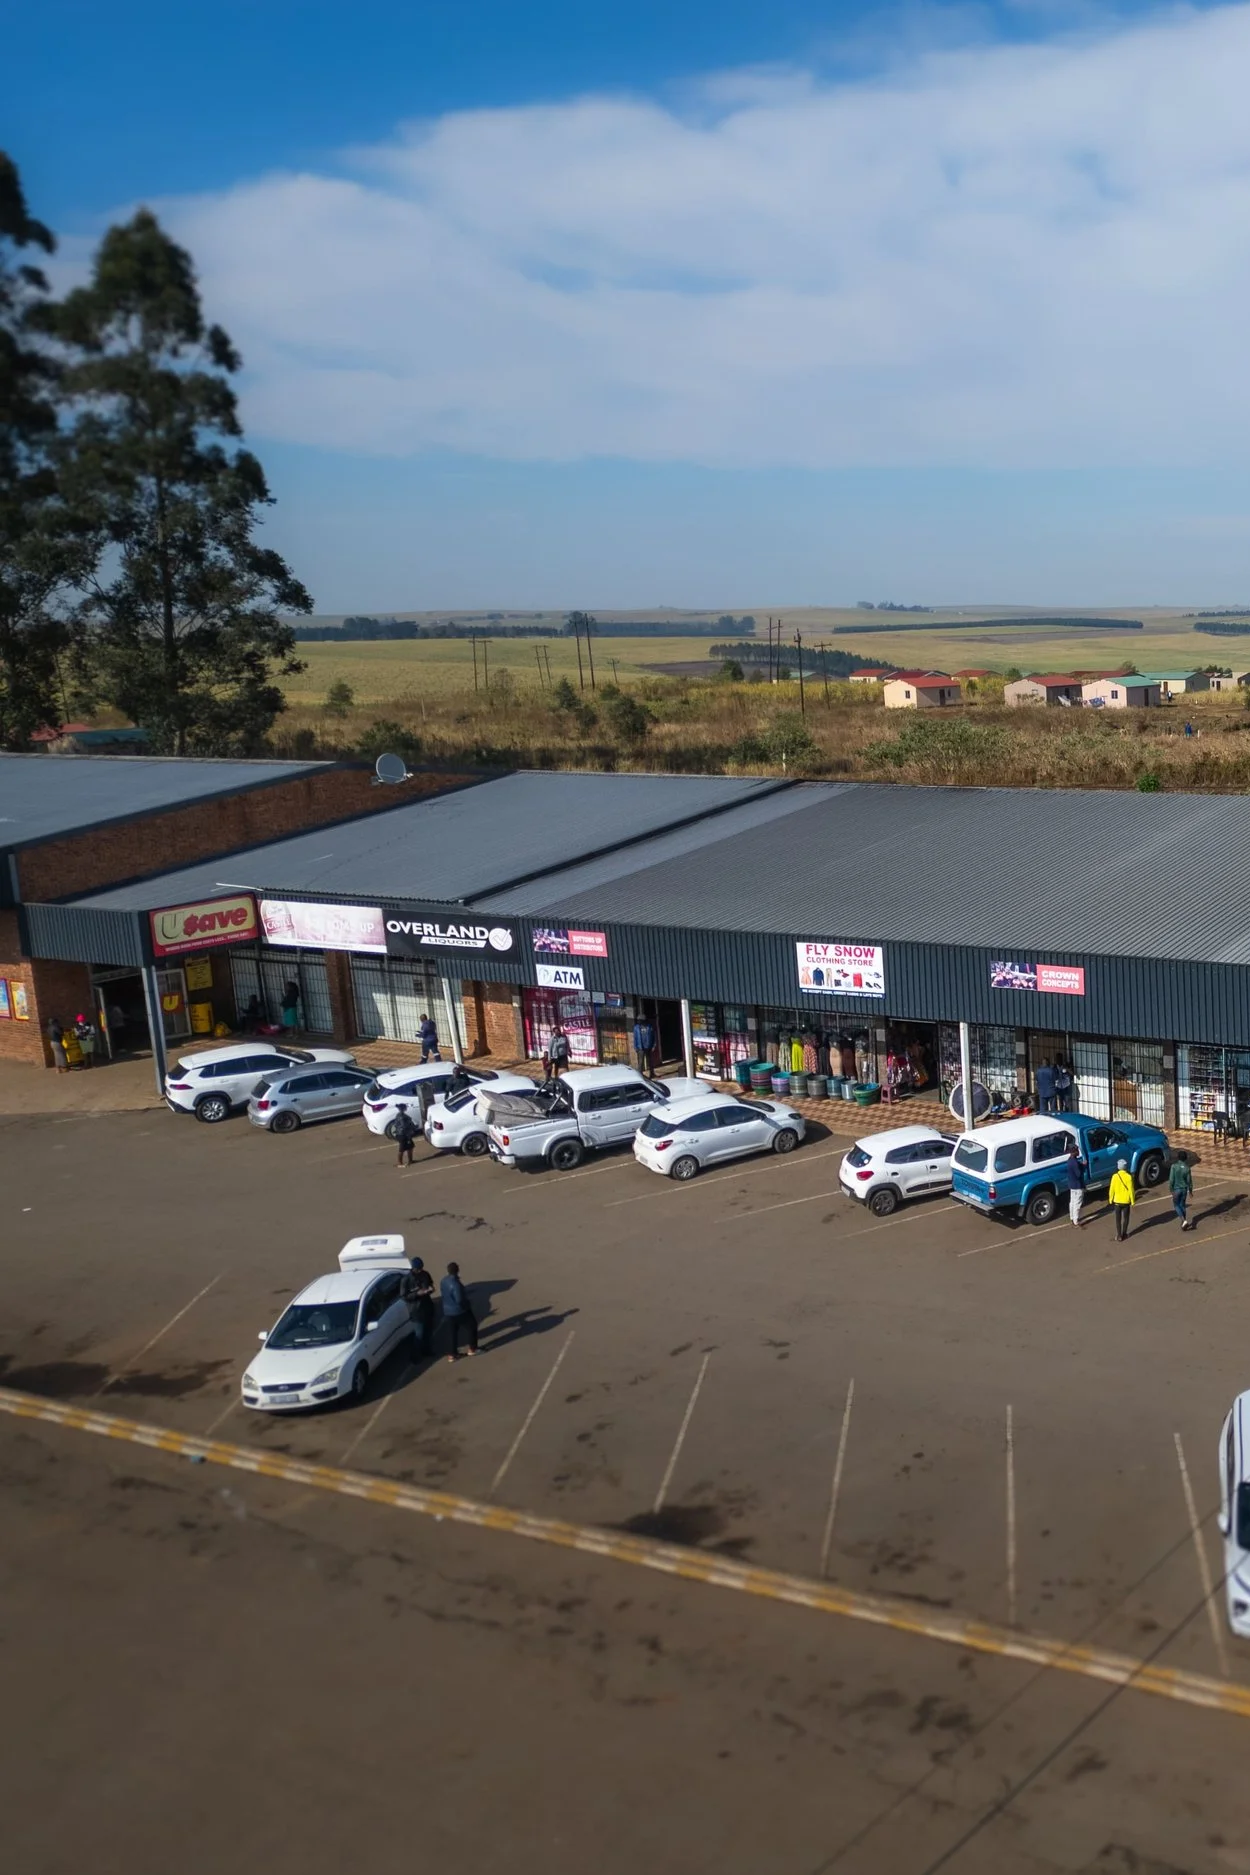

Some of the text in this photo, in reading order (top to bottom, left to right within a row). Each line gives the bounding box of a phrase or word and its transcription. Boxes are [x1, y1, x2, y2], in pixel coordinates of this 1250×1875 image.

[386, 920, 489, 940] OVERLAND
[428, 938, 478, 946] LIQUORS
[806, 944, 875, 958] FLY SNOW
[806, 956, 873, 967] CLOTHING STORE
[554, 971, 582, 985] ATM
[1041, 971, 1079, 980] CROWN
[1041, 979, 1080, 989] CONCEPTS
[563, 1018, 591, 1031] CASTLE
